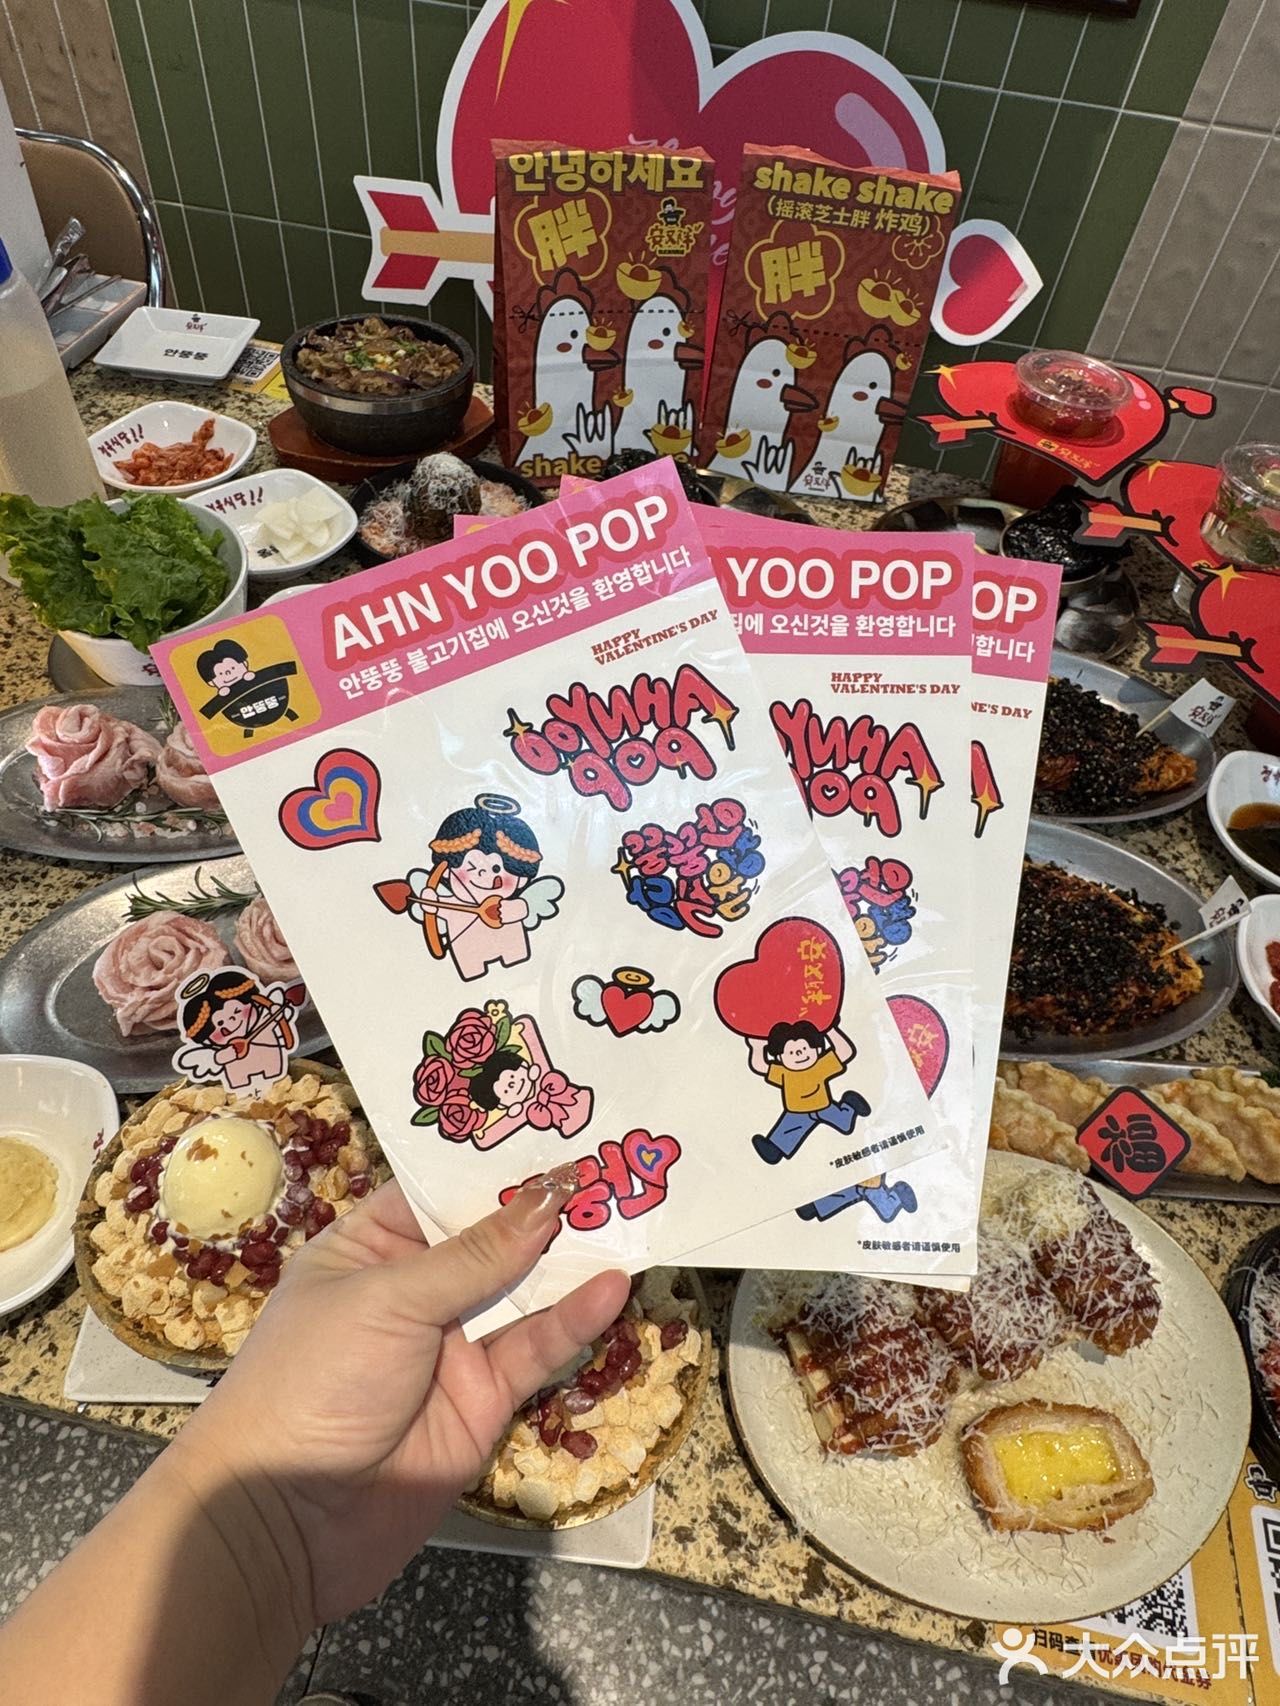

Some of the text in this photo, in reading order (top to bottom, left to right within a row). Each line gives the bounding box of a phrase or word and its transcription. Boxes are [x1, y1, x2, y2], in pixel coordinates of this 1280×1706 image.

[509, 150, 704, 192] 안녕하세요
[754, 162, 954, 214] shake shake
[527, 198, 598, 272] 胖
[760, 241, 826, 304] 胖
[520, 453, 600, 478] shake
[334, 496, 668, 660] AHN YOO POP
[726, 557, 953, 600] YOO POP
[339, 545, 691, 700] 안뚱뚱 불고기집에 오신것을 환영합니다
[972, 581, 1038, 623] OP
[591, 628, 641, 656] HAPPY
[595, 609, 718, 665] VALENTINE'S DAY
[770, 613, 849, 637] 오신것을
[855, 615, 957, 638] 환영합니다
[972, 634, 1036, 663] 합니다
[831, 672, 883, 683] HAPPY
[831, 684, 961, 694] VALENTINE'S DAY
[1001, 705, 1032, 719] DAY
[1098, 1112, 1167, 1173] 福
